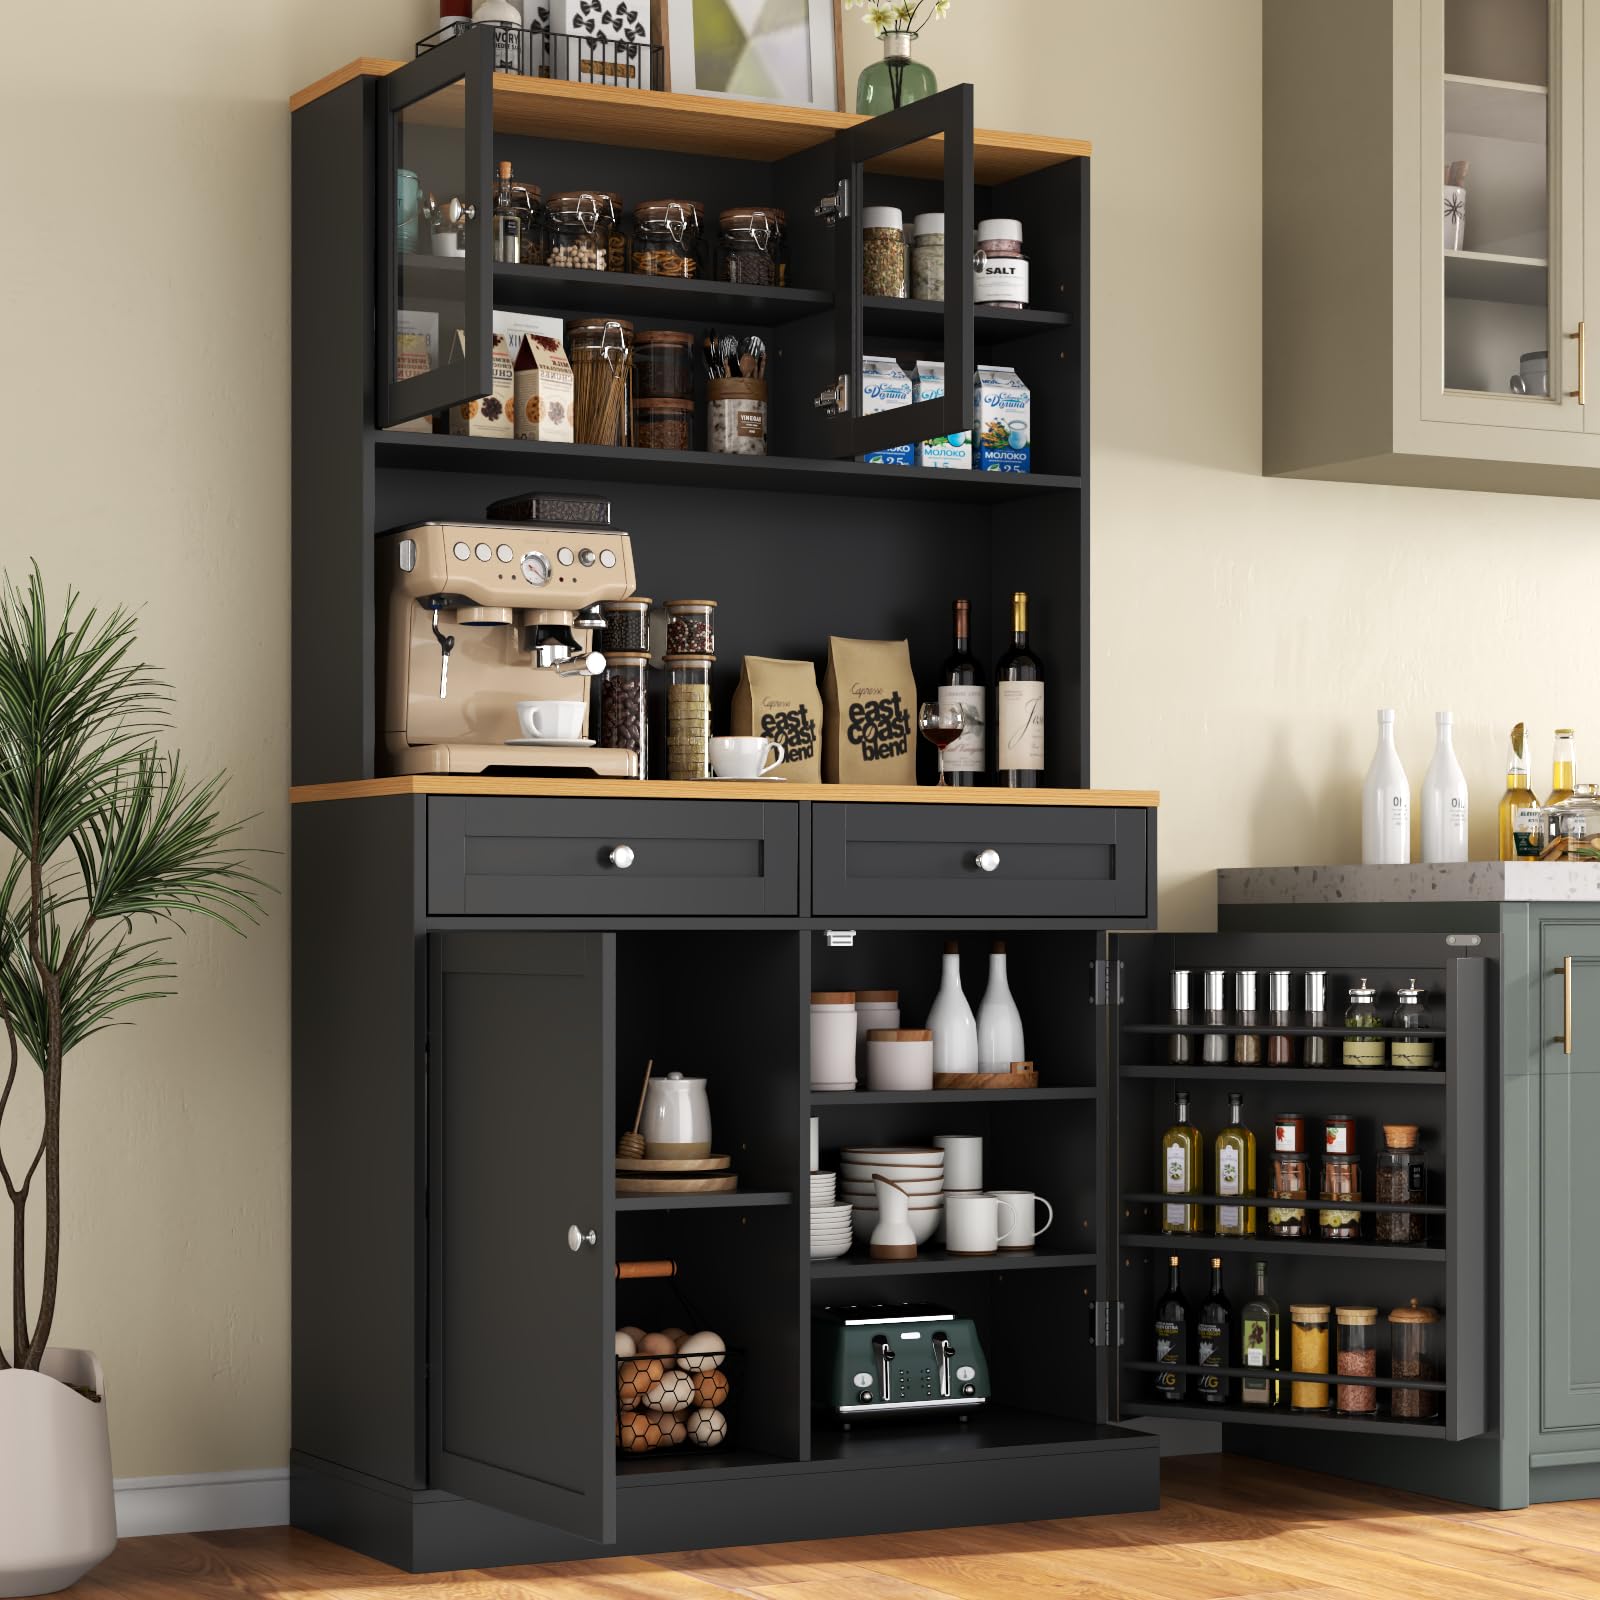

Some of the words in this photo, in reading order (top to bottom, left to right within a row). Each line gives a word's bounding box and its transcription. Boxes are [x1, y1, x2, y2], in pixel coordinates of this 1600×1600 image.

[985, 267, 1016, 275] SALT
[740, 414, 762, 422] VINEGAR
[924, 448, 966, 458] МОЛОКО
[984, 451, 1027, 461] МОЛОКО
[849, 691, 904, 724] east
[761, 703, 809, 733] east
[847, 709, 911, 745] coast
[861, 733, 908, 761] blend
